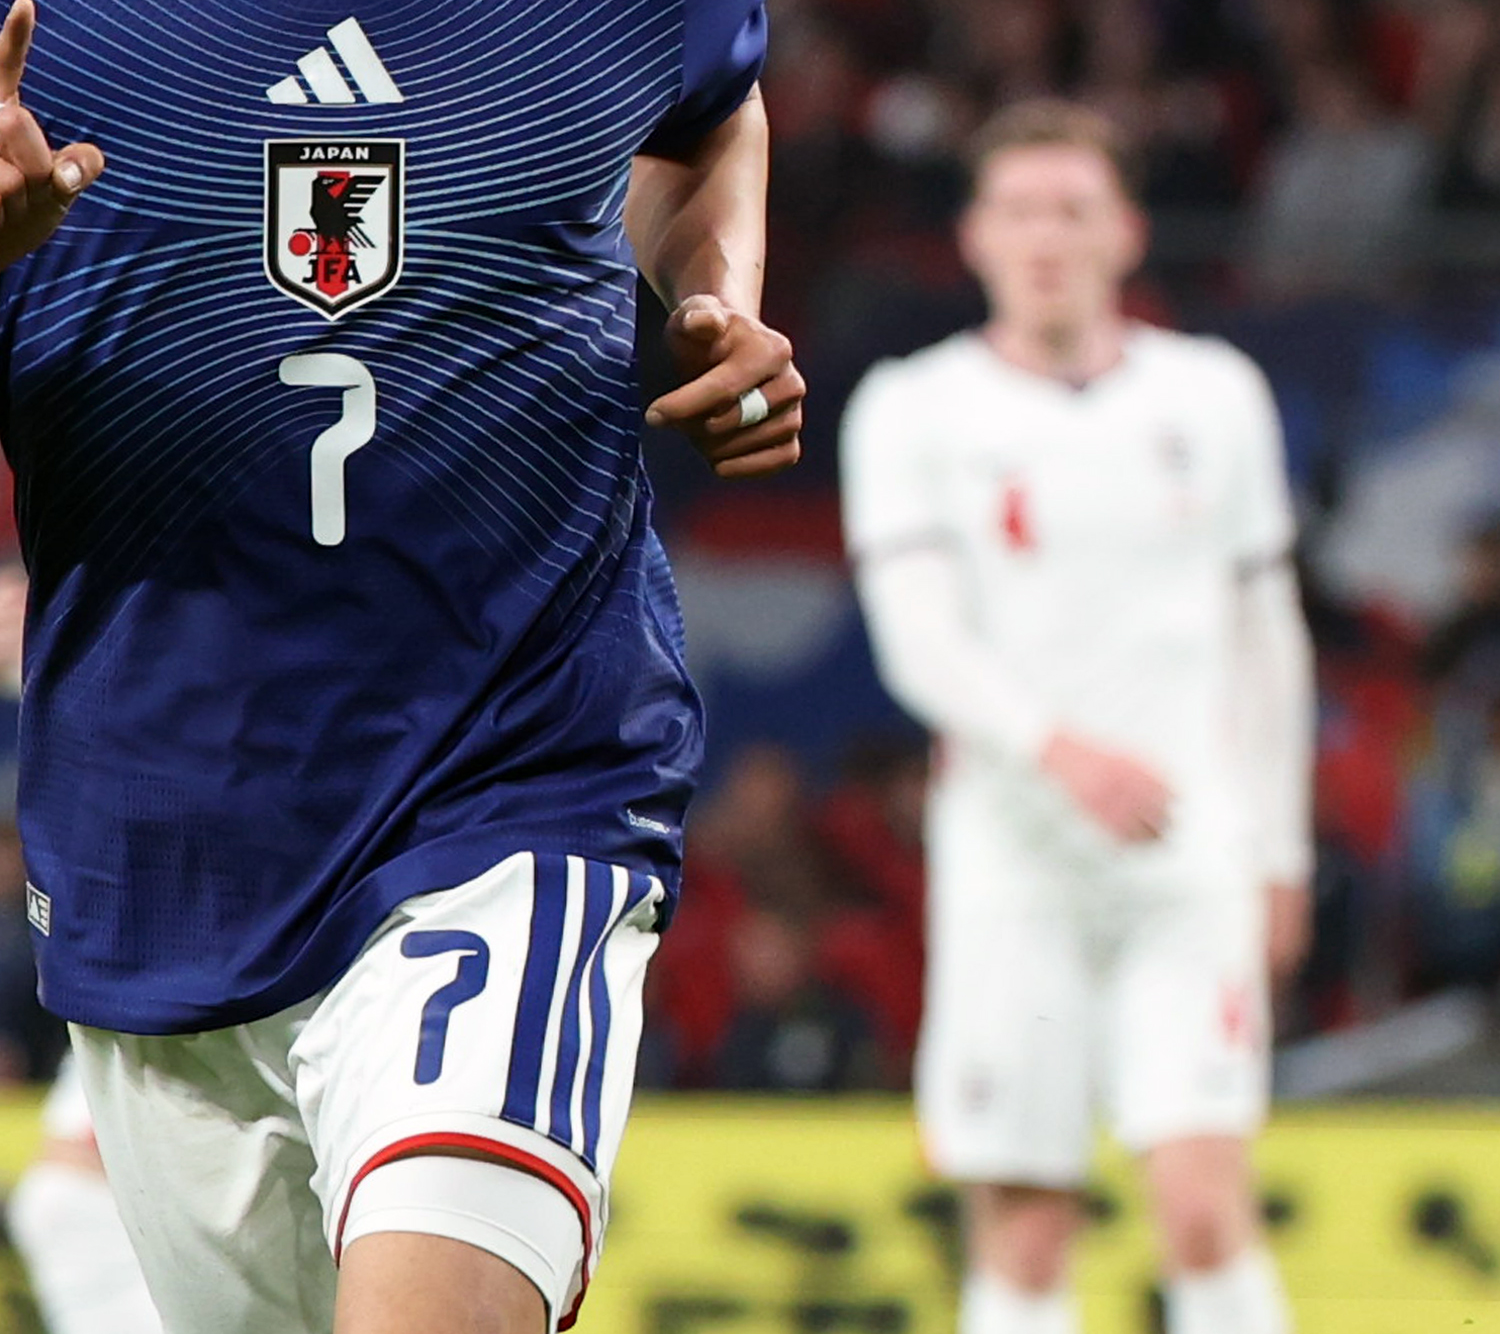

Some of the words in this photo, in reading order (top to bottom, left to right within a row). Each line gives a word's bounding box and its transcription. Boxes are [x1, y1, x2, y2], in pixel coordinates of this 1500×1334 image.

[300, 147, 369, 160] JAPAN
[302, 257, 362, 283] JFA
[279, 353, 376, 546] 7
[400, 930, 491, 1085] 7
